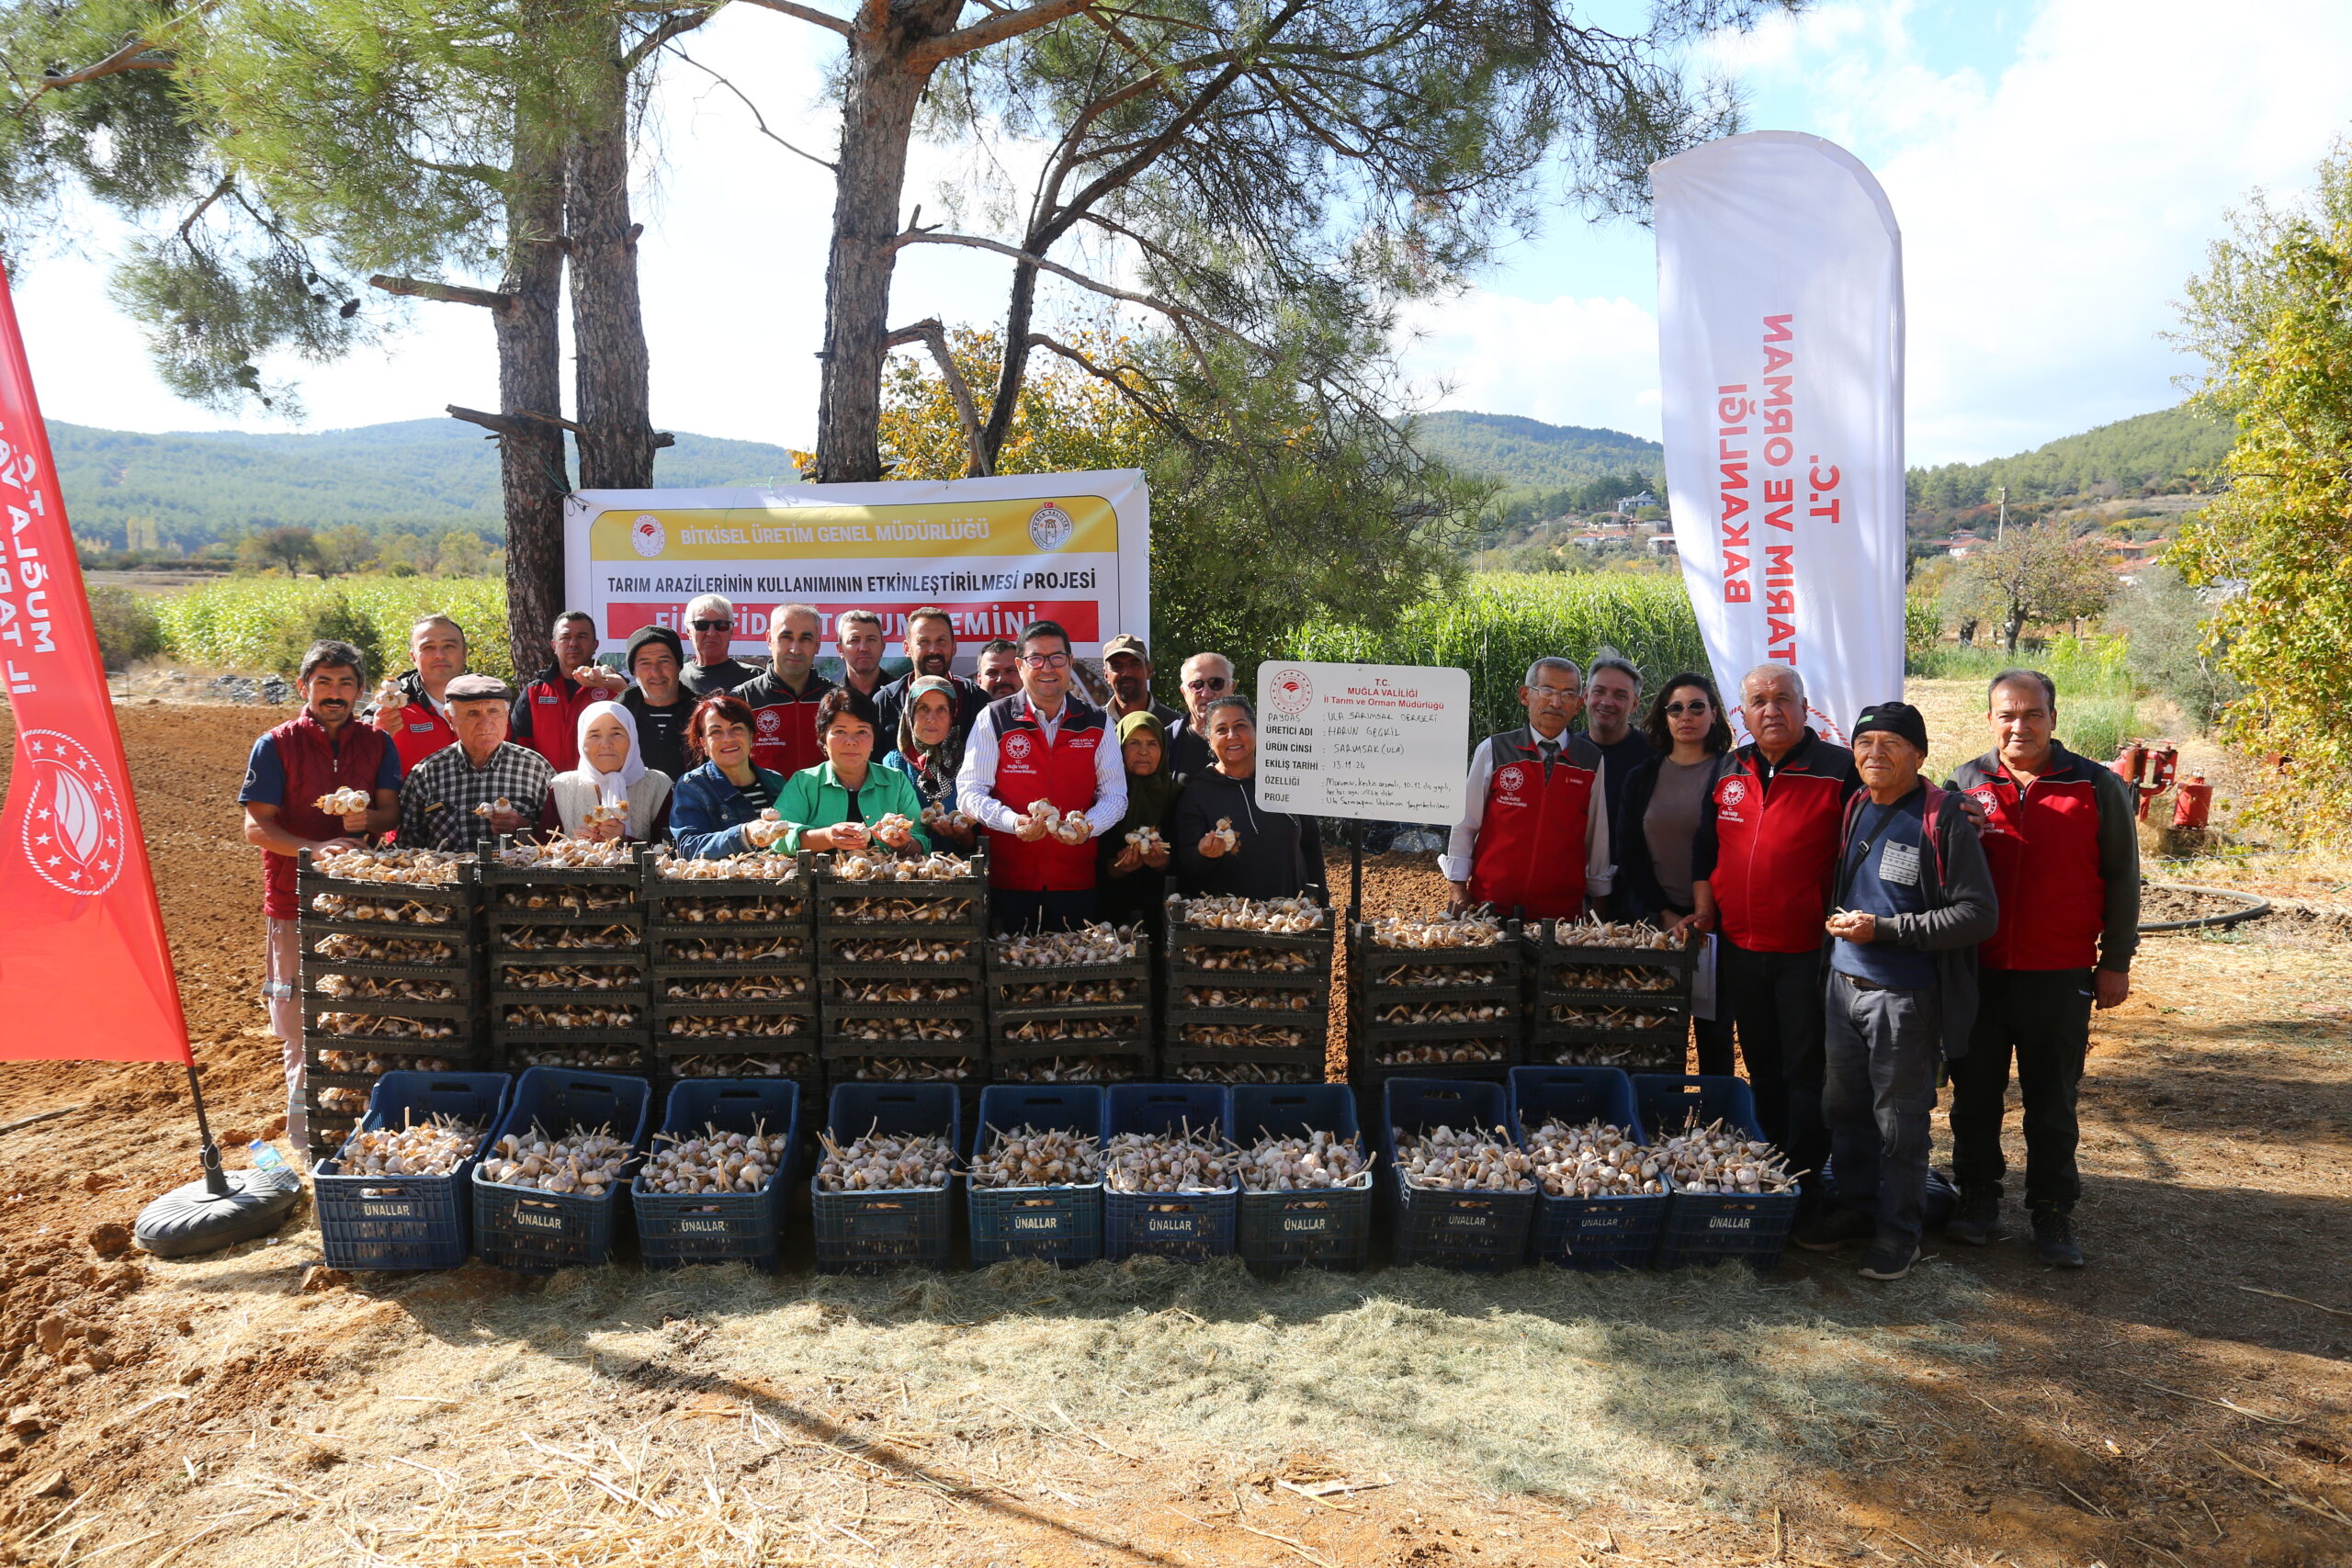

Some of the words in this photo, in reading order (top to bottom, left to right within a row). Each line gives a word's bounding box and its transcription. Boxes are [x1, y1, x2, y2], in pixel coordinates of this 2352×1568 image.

[681, 525, 750, 545] BİTKİSEL
[752, 523, 814, 543] ÜRETİM
[818, 525, 873, 542] GENEL
[875, 517, 990, 541] MÜDÜRLÜĞÜ
[607, 577, 650, 592] TARIM
[655, 573, 752, 592] ARAZİLERİNİN
[757, 576, 863, 592] KULLANIMININ
[867, 570, 1020, 595] ETKİNLEŞTİRİLMESİ
[1023, 568, 1096, 590] PROJESİ
[1374, 678, 1391, 687] T.C.
[1348, 687, 1379, 695] MUĞLA
[1382, 688, 1418, 698] VALİLİĞİ
[1332, 696, 1353, 705] Tarım
[1368, 698, 1396, 707] Orman
[1398, 700, 1444, 710] Müdürlüğü
[1266, 724, 1297, 735] ÜRETİCİ
[1299, 728, 1313, 736] ADI
[1265, 740, 1288, 751] ÜRÜN
[1290, 742, 1312, 753] CİNSİ
[1265, 758, 1290, 771] EKİLİŞ
[1293, 760, 1318, 771] TARİHİ
[1265, 774, 1300, 785] ÖZELLİĞİ
[1265, 793, 1290, 802] PROJE
[518, 1212, 562, 1230] ÜNALLAR
[681, 1220, 726, 1233] ÜNALLAR
